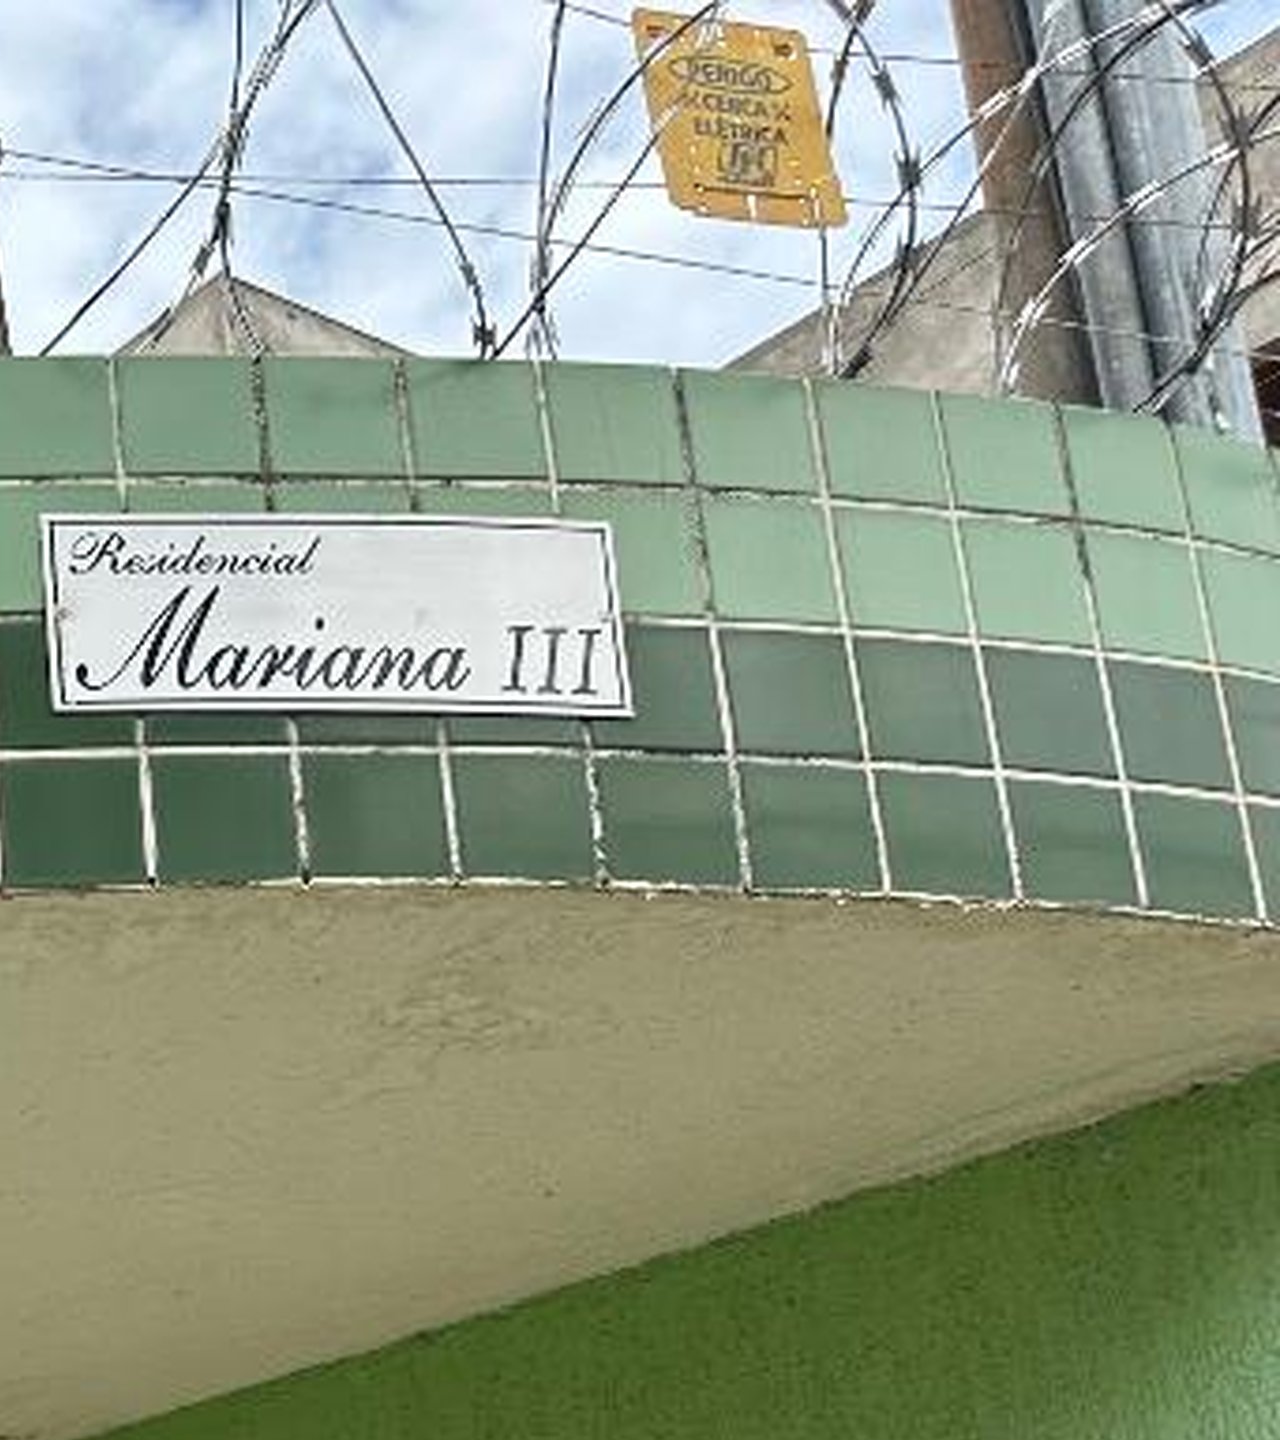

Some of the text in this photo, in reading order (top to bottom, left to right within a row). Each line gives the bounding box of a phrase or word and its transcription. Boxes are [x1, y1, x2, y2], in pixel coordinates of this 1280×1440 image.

[70, 531, 321, 576] Residencial
[76, 585, 603, 696] Mariana III
